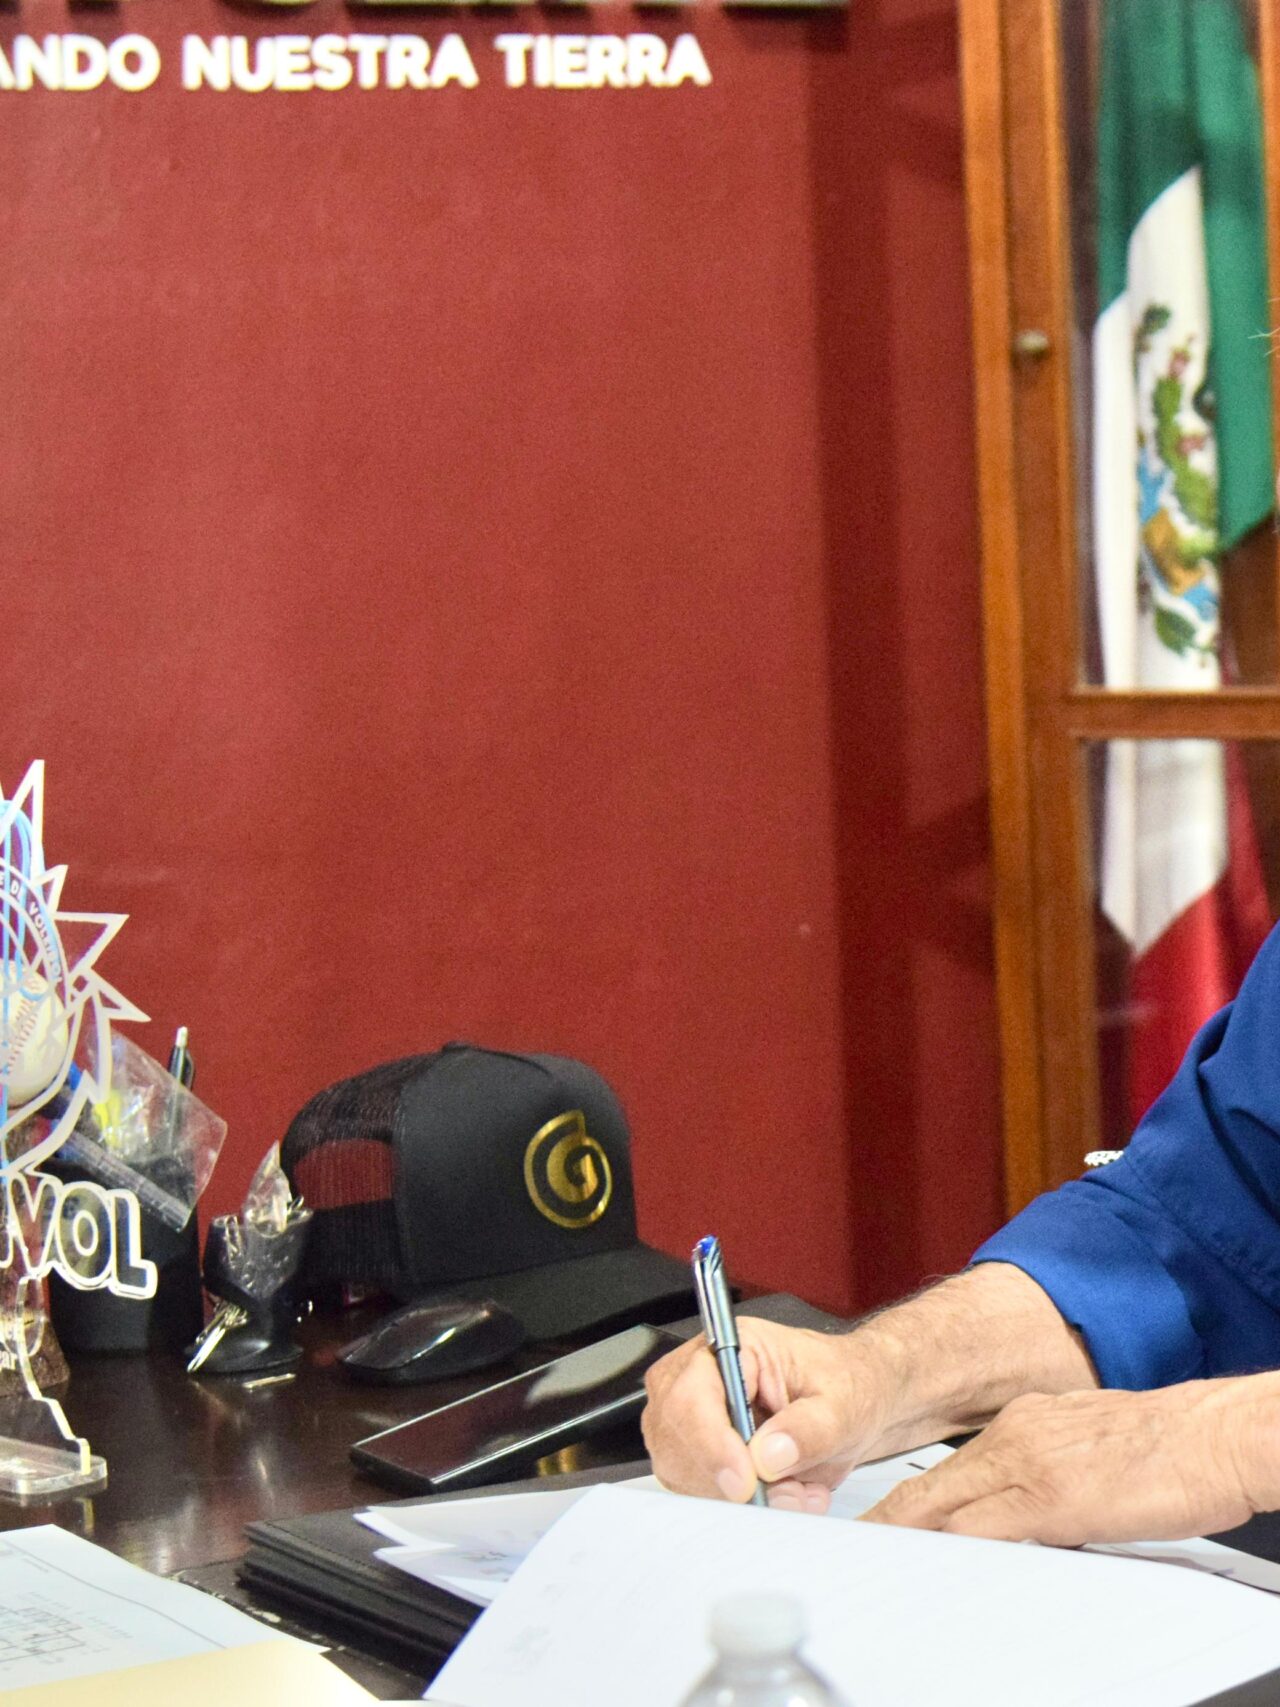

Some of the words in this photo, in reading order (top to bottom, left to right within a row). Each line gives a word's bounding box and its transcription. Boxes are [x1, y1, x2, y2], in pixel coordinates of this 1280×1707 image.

[183, 34, 479, 91] NUESTRA
[496, 34, 711, 88] TIERRA
[0, 1172, 158, 1299] VOL
